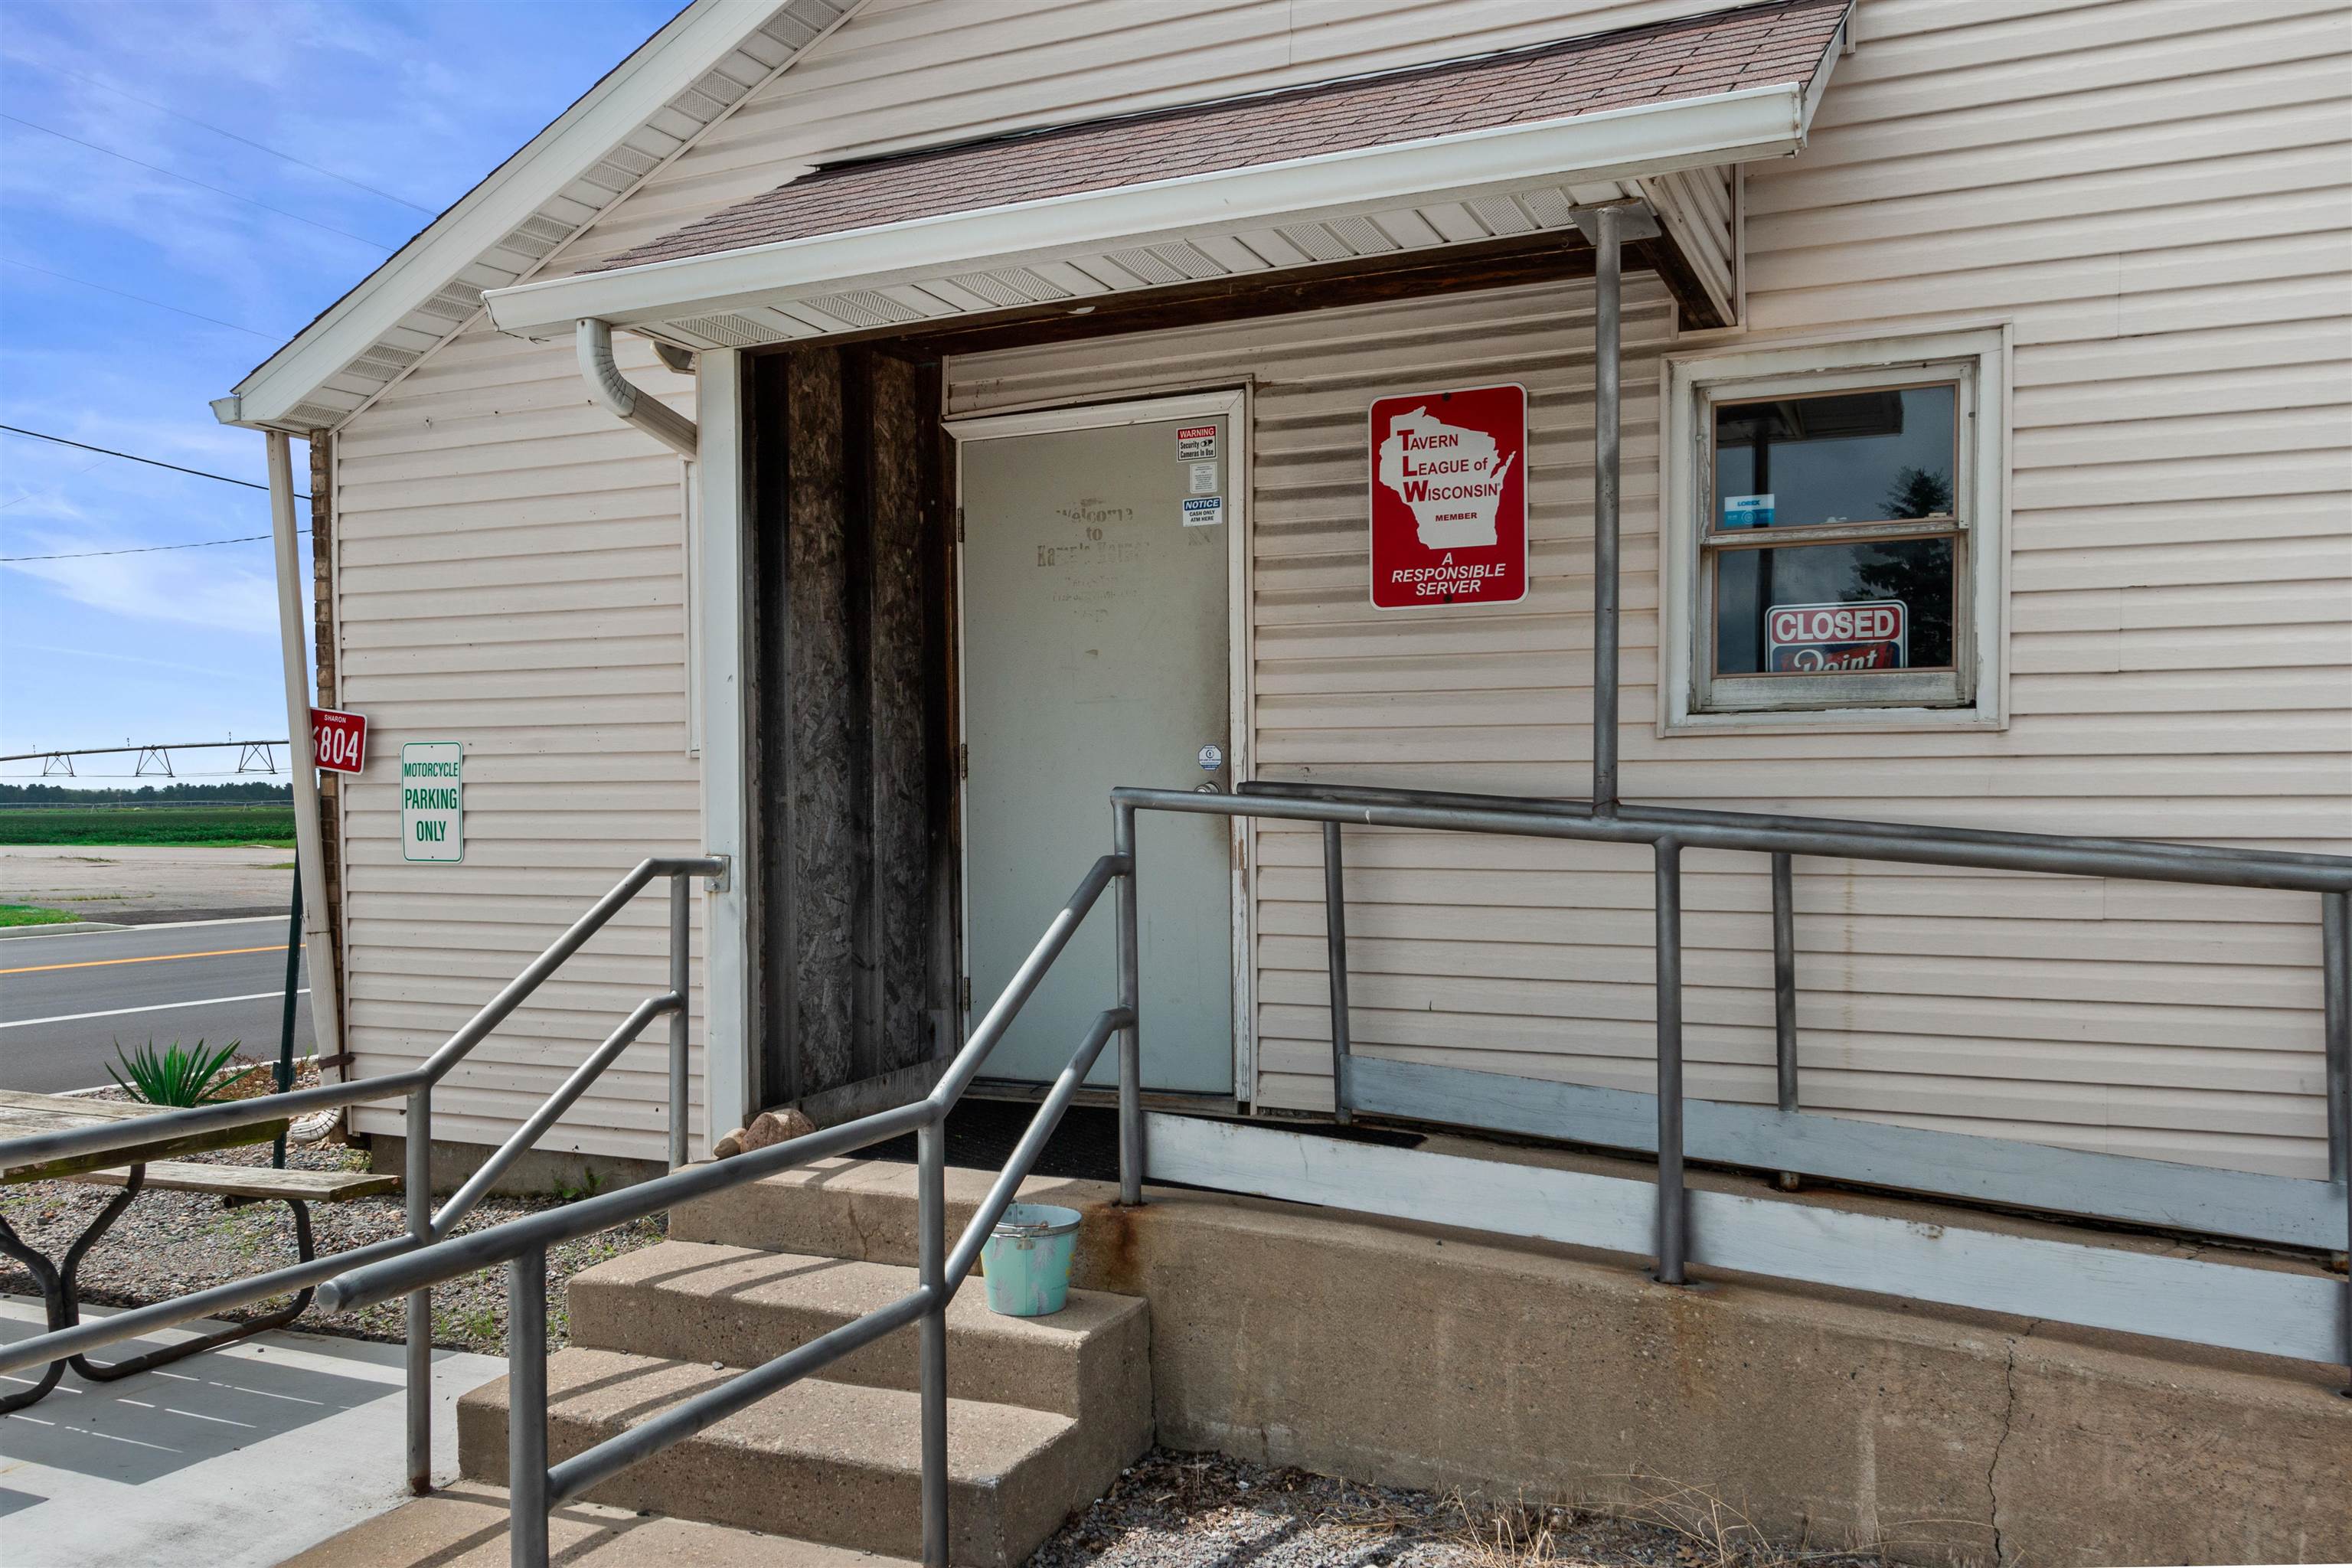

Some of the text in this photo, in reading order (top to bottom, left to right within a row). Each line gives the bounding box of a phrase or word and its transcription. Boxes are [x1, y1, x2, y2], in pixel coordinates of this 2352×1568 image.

[1180, 427, 1214, 439] WARNING
[1396, 429, 1459, 451] TAVERN
[1180, 441, 1200, 449] Security
[1180, 450, 1199, 459] Cameras
[1205, 448, 1214, 456] Use
[1402, 455, 1488, 477] LEAGUE of
[1403, 479, 1498, 503] WISCONSIN
[1185, 498, 1220, 510] NOTICE
[1435, 511, 1478, 522] MEMBER
[1086, 527, 1103, 541] to
[1442, 552, 1453, 565] A
[1392, 563, 1506, 583] RESPONSIBLE
[1416, 580, 1481, 596] SERVER
[1775, 609, 1895, 642] CLOSED
[324, 714, 347, 724] SHARON
[403, 762, 459, 777] MOTORCYCLE
[405, 788, 458, 809] PARKING
[416, 820, 447, 841] ONLY
